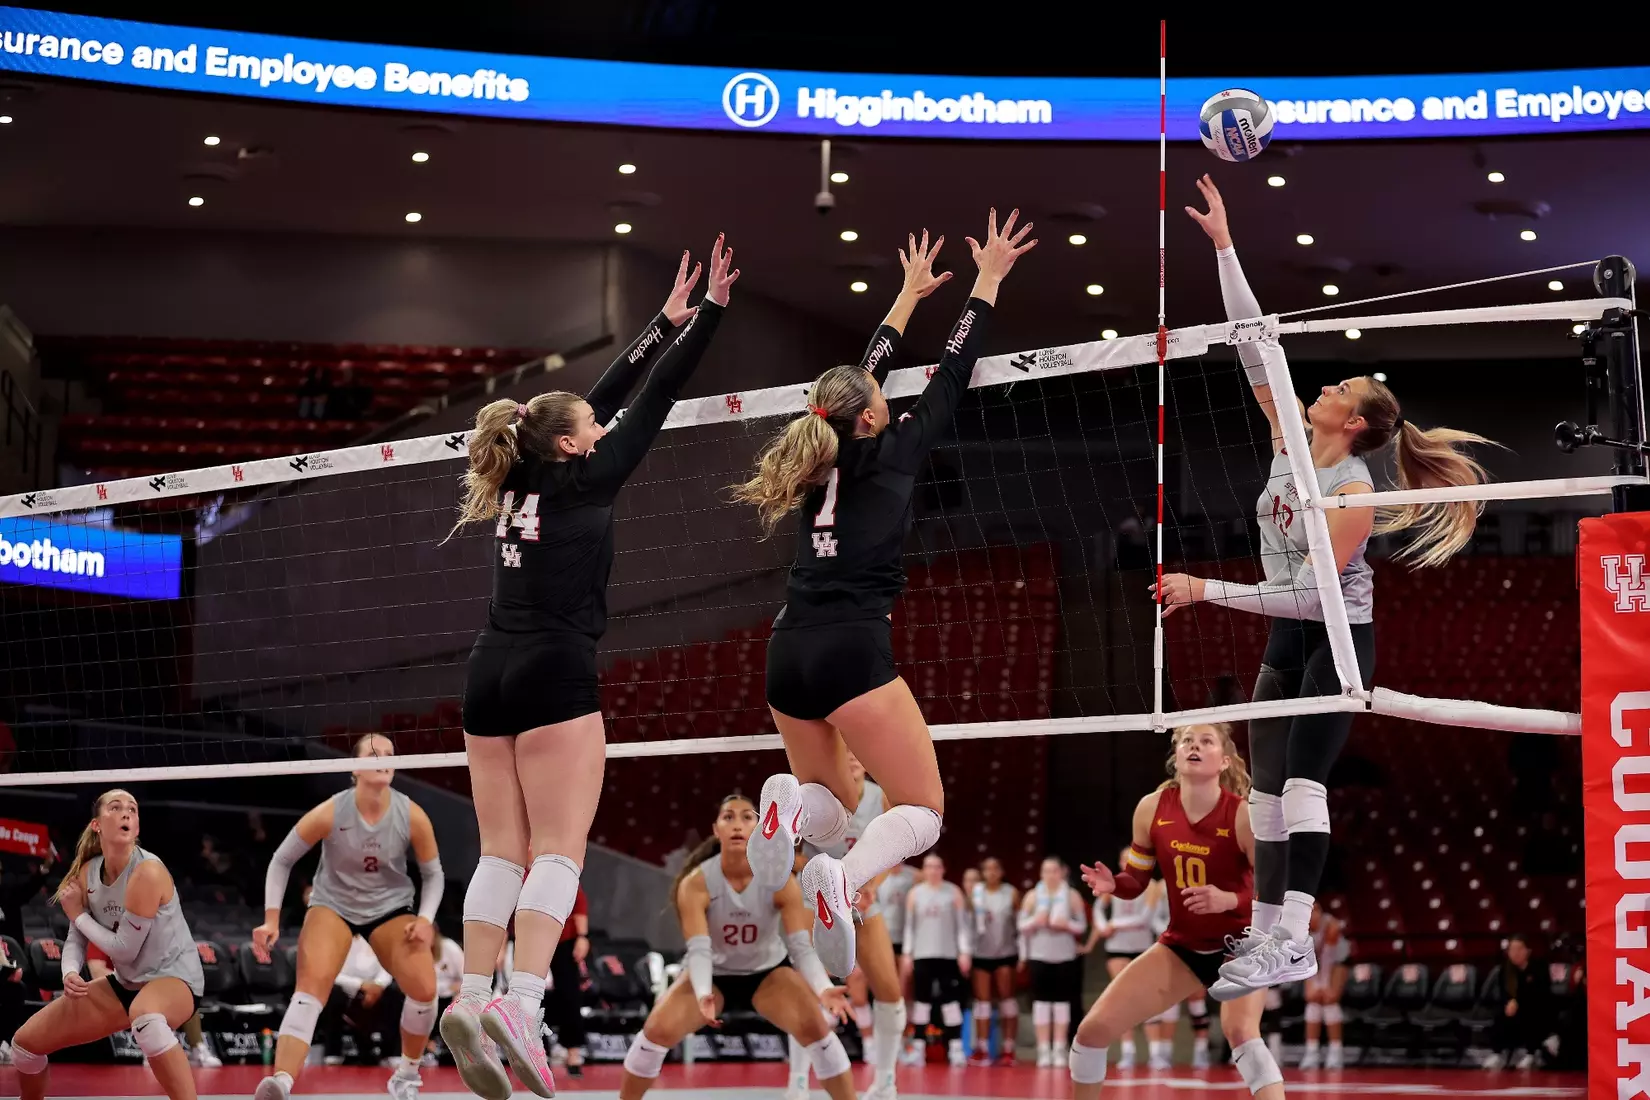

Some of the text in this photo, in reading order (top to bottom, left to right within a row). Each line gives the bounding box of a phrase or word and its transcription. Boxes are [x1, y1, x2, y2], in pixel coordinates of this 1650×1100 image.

[131, 44, 197, 73] and
[205, 46, 376, 92] Employee
[383, 62, 528, 101] Benefits
[797, 86, 1052, 127] Higginbotham
[1421, 89, 1488, 121] and
[1239, 117, 1259, 155] molten
[945, 309, 977, 355] Houston
[1240, 320, 1263, 330] Senoh
[627, 325, 664, 364] Houston
[1039, 352, 1067, 363] HOUSTON
[1039, 359, 1074, 369] VOLLEYBALL
[725, 394, 743, 414] UH
[232, 466, 243, 482] UH
[96, 484, 107, 500] UH
[814, 467, 840, 528] 7
[495, 490, 540, 542] 14
[500, 542, 522, 568] UH
[811, 531, 838, 558] UH
[1599, 555, 1650, 612] UH
[1170, 840, 1210, 856] Cyclones
[363, 856, 379, 873] 2
[1174, 855, 1207, 889] 10
[723, 924, 758, 946] 20
